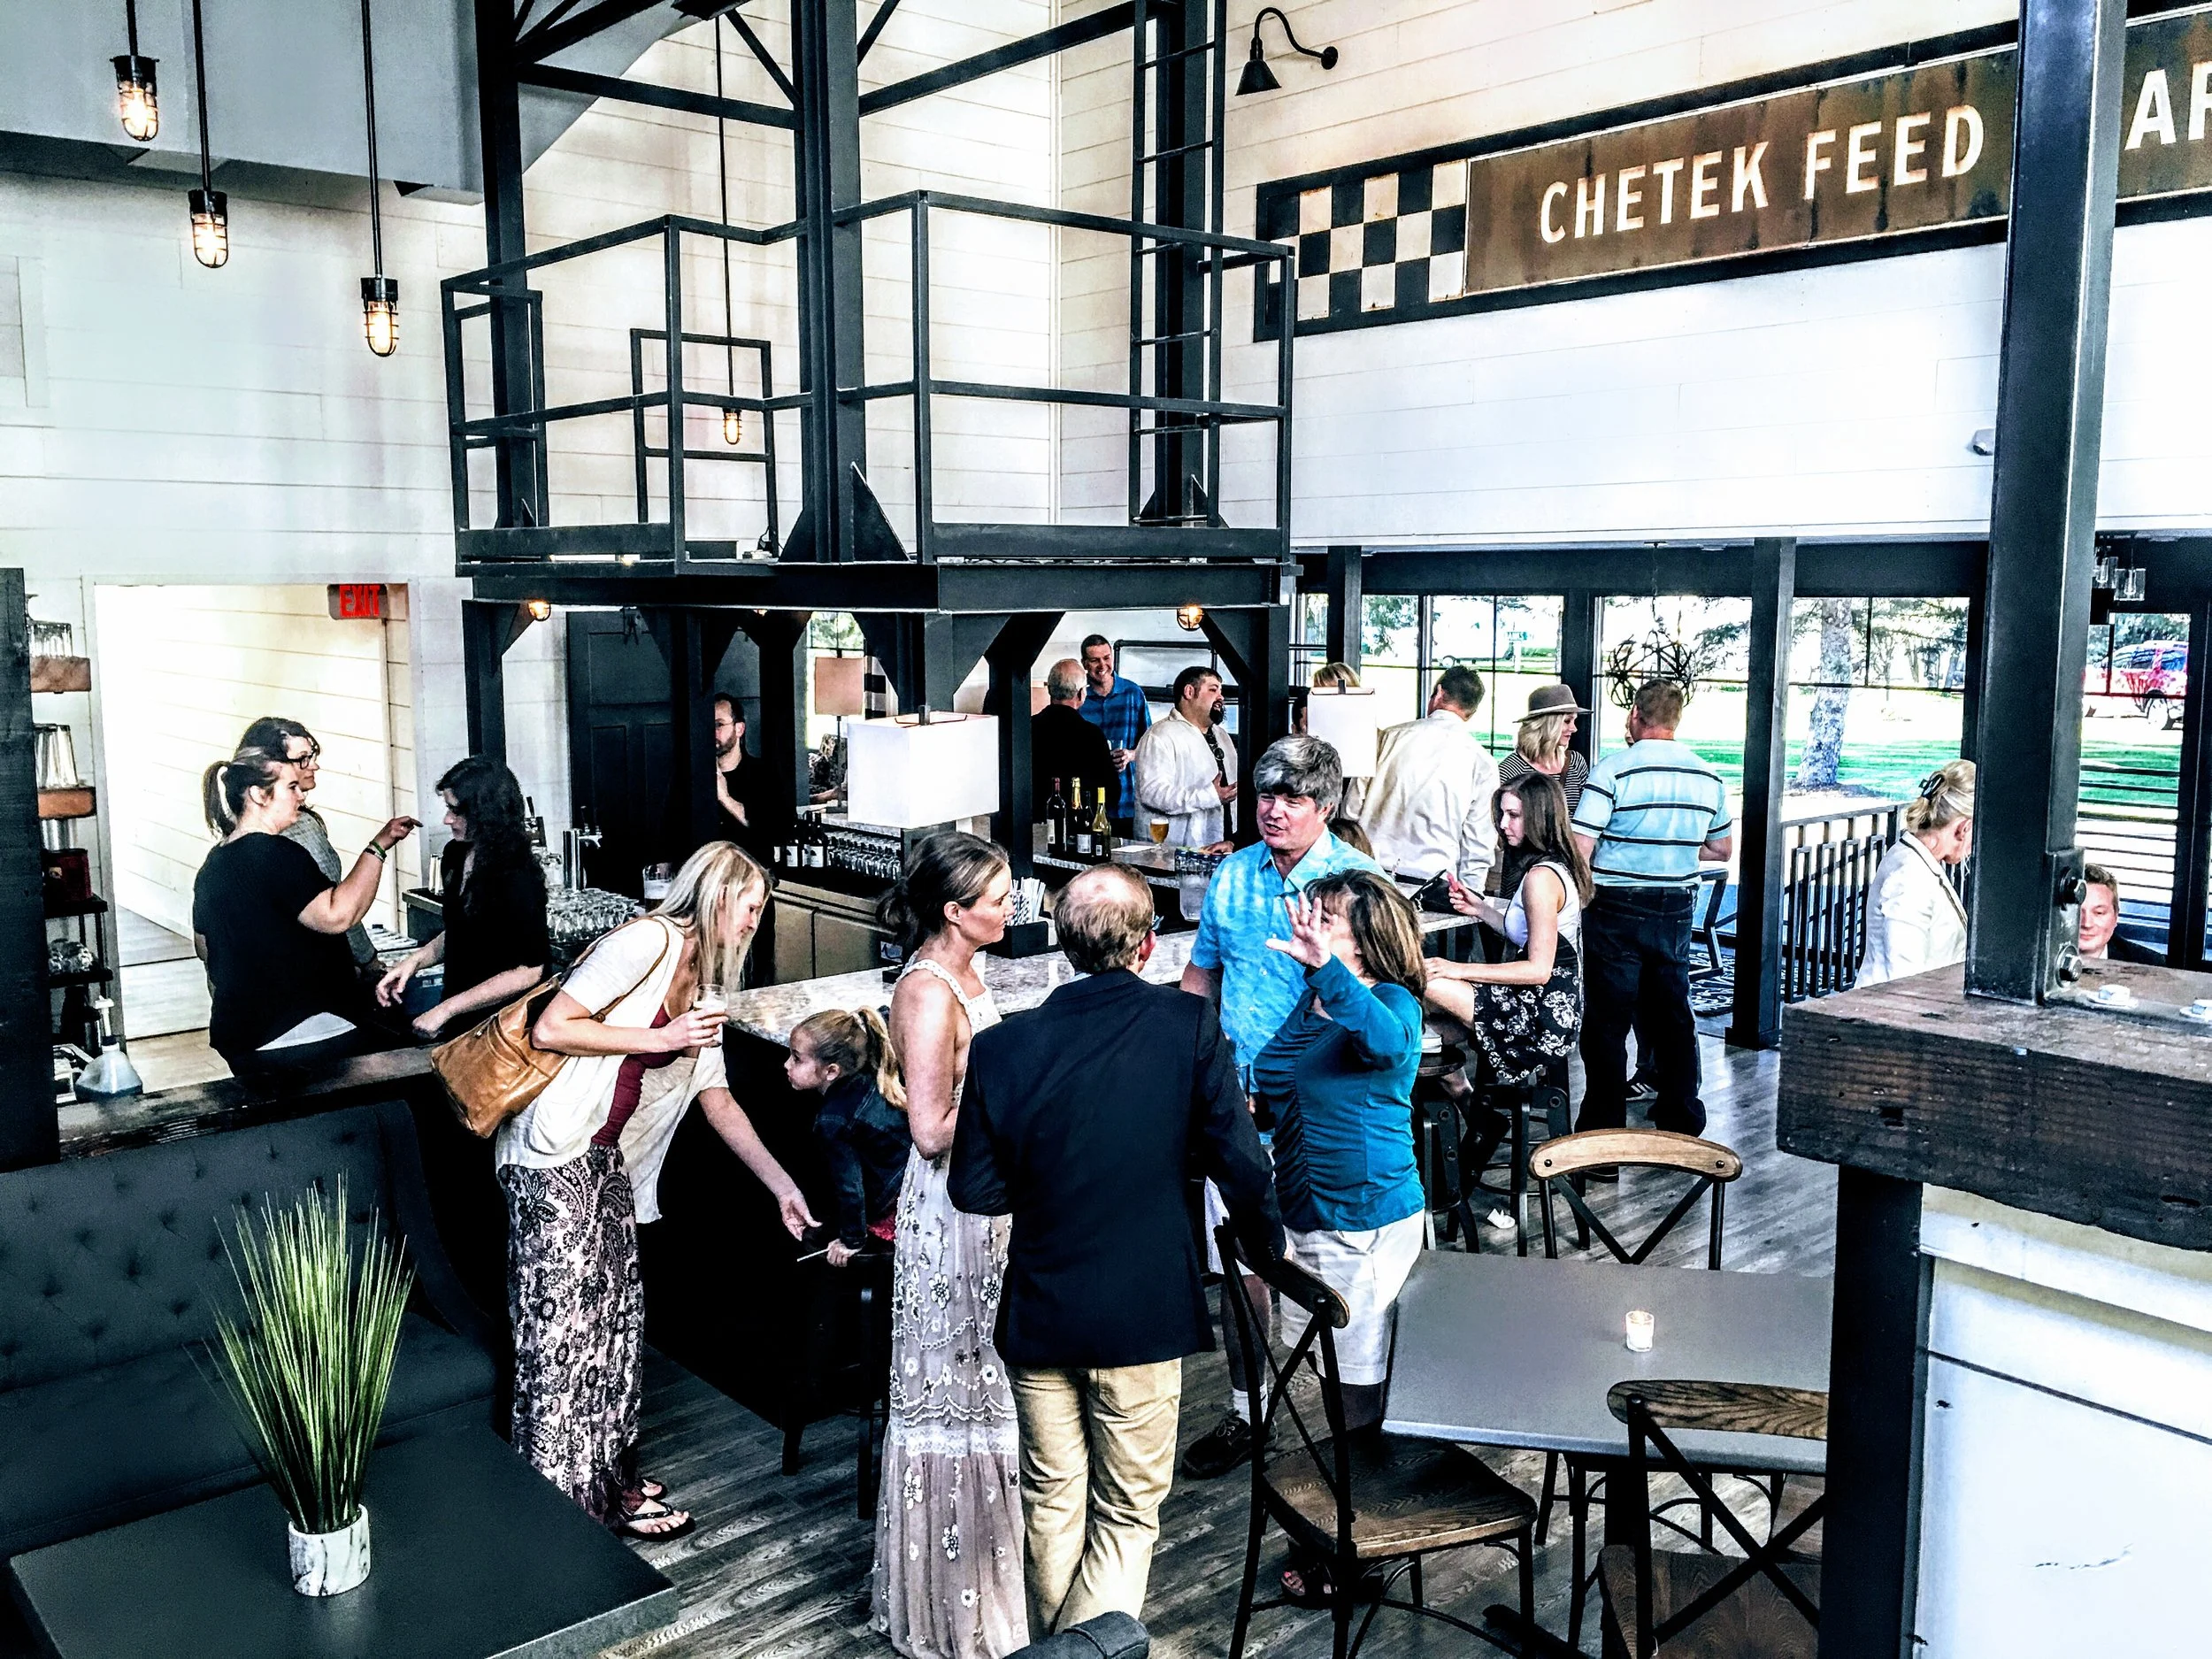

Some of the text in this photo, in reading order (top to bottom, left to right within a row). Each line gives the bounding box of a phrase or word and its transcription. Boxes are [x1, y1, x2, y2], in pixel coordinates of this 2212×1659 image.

[1540, 142, 1769, 243] CHETEK
[1803, 104, 1984, 200] FEED
[339, 585, 380, 618] EXIT
